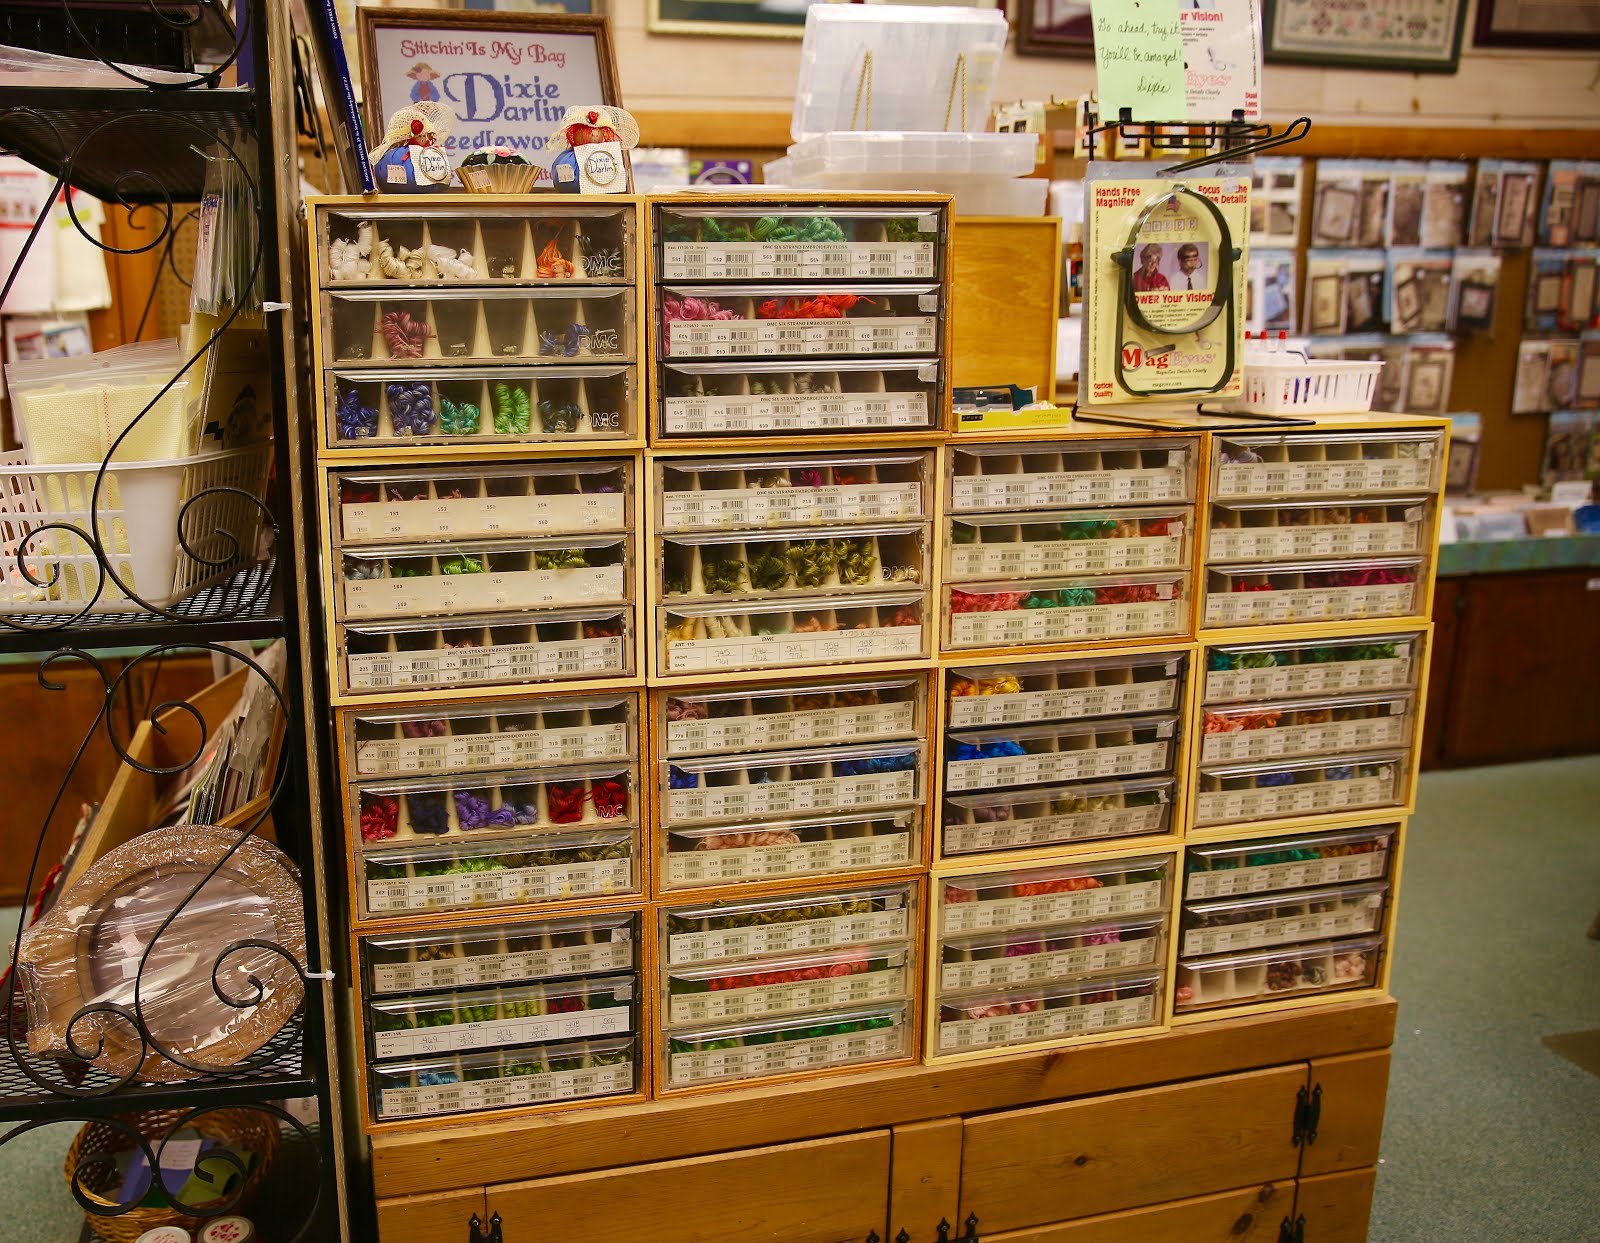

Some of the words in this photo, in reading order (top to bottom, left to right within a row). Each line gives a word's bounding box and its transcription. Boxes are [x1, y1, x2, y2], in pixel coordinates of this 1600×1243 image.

[1191, 12, 1223, 21] Vision!
[1098, 17, 1111, 32] Go
[1118, 21, 1149, 36] ahead,
[466, 42, 486, 56] Is
[490, 41, 522, 65] My
[528, 44, 566, 68] Bag
[1133, 47, 1143, 62] be
[1137, 75, 1171, 96] Dixie
[443, 72, 560, 122] Dixie
[1096, 188, 1120, 197] Hands
[1122, 187, 1141, 196] Free
[1198, 185, 1220, 194] Focus
[1096, 197, 1135, 208] Magnifier
[1221, 195, 1247, 204] Details
[1162, 294, 1183, 303] Your
[578, 335, 618, 349] DMC
[1122, 348, 1214, 370] MagEyes
